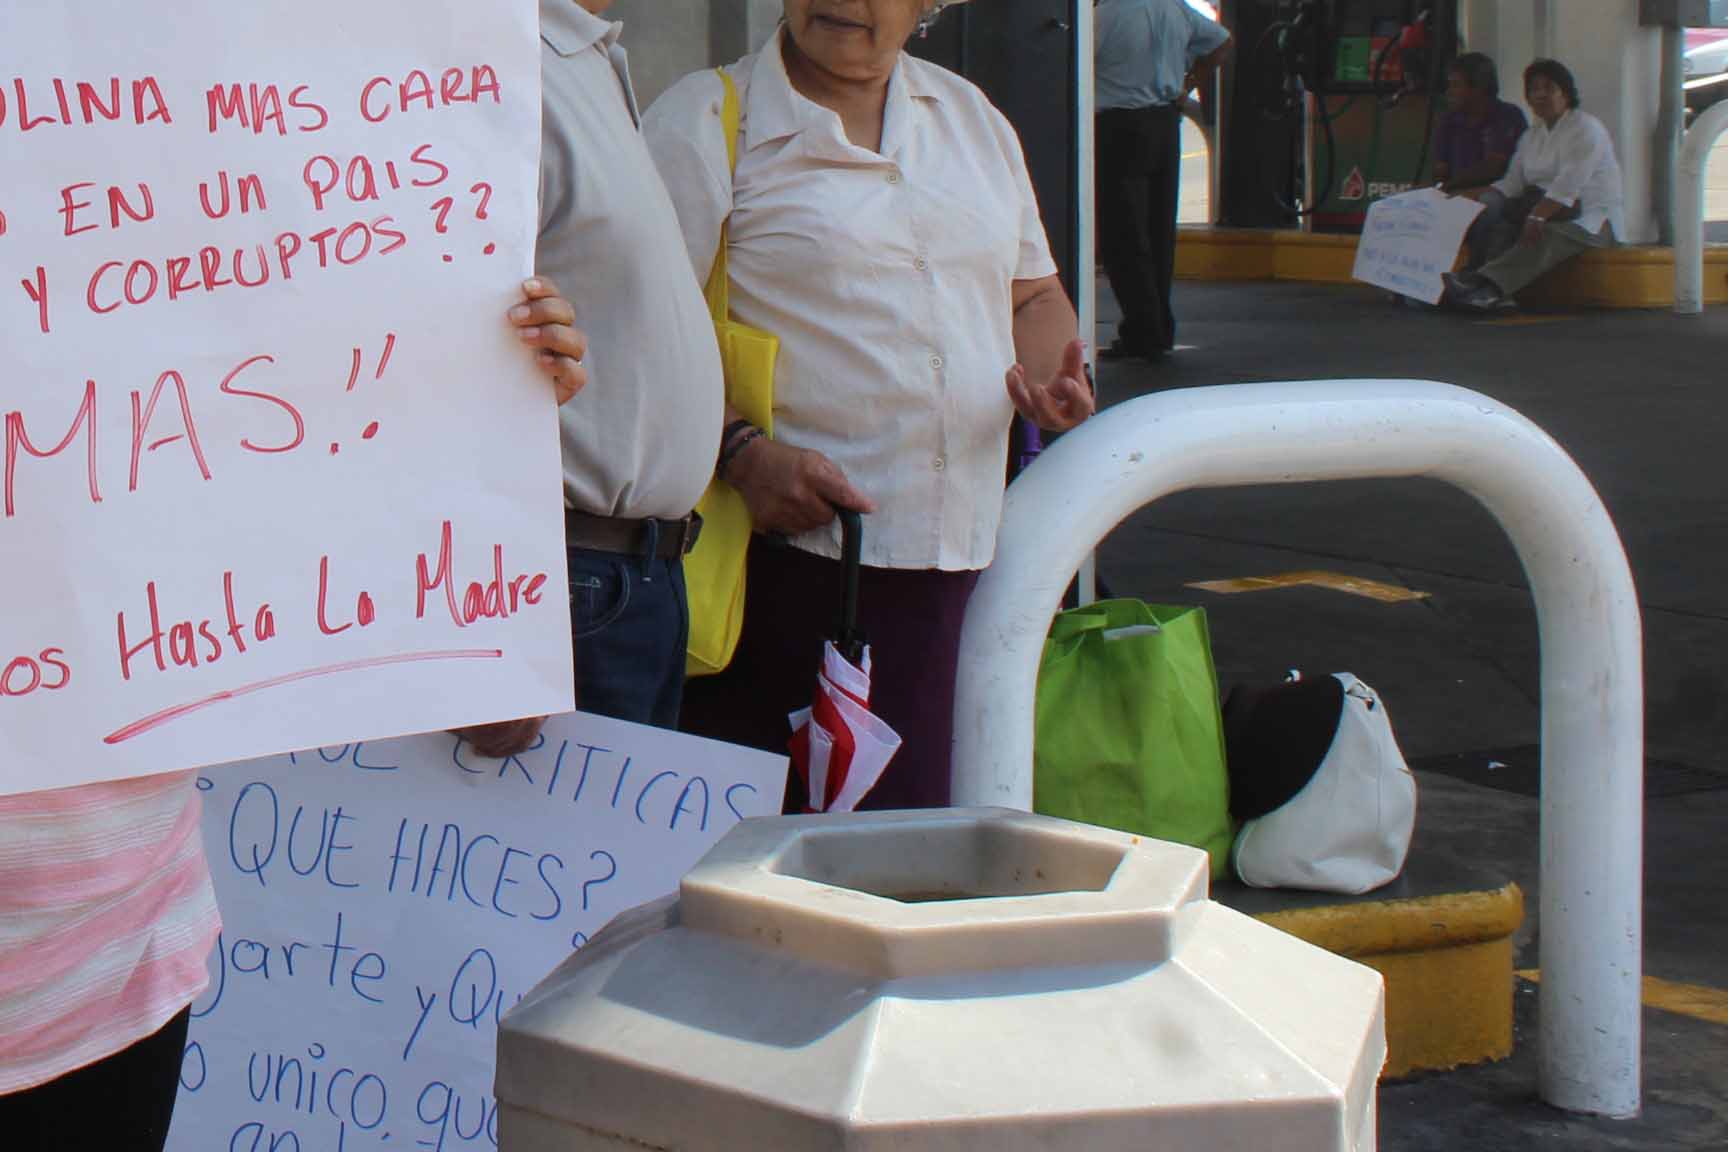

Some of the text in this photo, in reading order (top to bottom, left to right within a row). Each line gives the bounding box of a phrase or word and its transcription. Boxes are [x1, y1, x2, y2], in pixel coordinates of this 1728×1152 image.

[206, 81, 329, 136] MAS
[359, 64, 502, 124] CARA
[57, 182, 155, 237] EN
[21, 266, 50, 333] Y
[117, 580, 276, 681] Hasta
[317, 554, 375, 635] La
[416, 520, 547, 628] Madre
[388, 818, 616, 921] HACES?
[403, 985, 436, 1061] y
